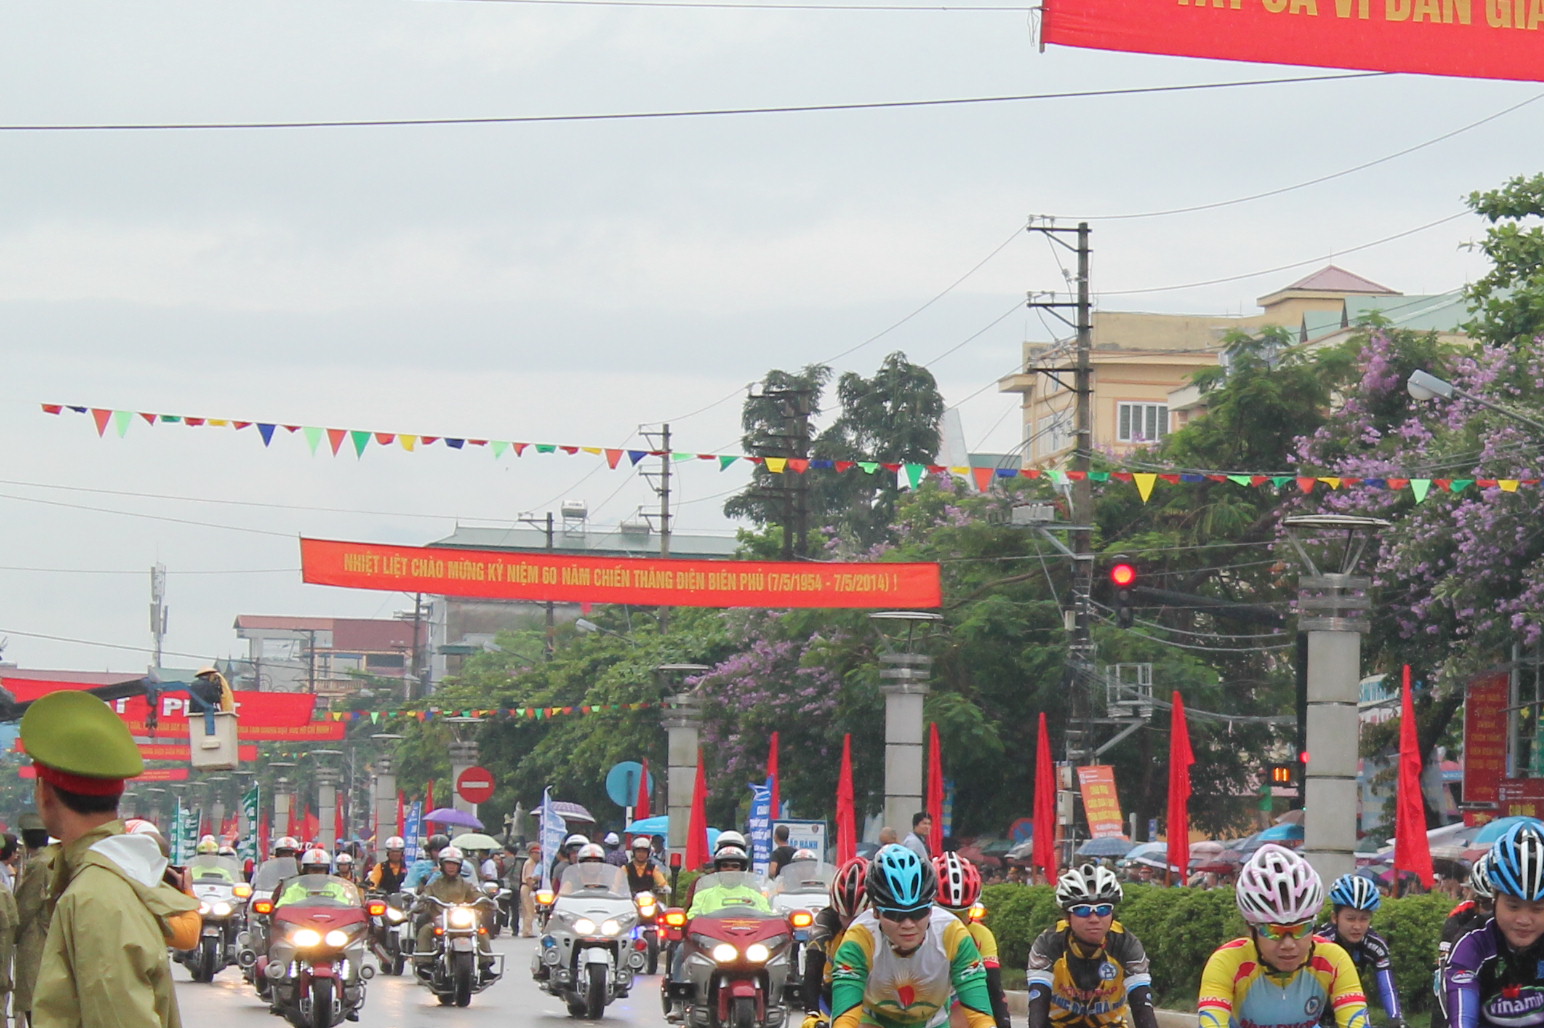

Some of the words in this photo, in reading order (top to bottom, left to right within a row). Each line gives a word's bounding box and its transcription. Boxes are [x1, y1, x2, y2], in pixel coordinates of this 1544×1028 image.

[343, 552, 379, 576] NHIỆT
[383, 555, 407, 578] LIỆT
[411, 556, 444, 579] CHÀO
[447, 558, 485, 581] MỪNG
[507, 561, 539, 586] NIỆM
[542, 566, 557, 585] 60
[562, 564, 590, 586] NĂM
[594, 564, 631, 588] CHIẾN
[633, 566, 673, 589] THẮNG
[676, 568, 705, 593] ĐIỆN
[708, 569, 736, 591] BIÊN
[740, 568, 764, 591] PHỦ
